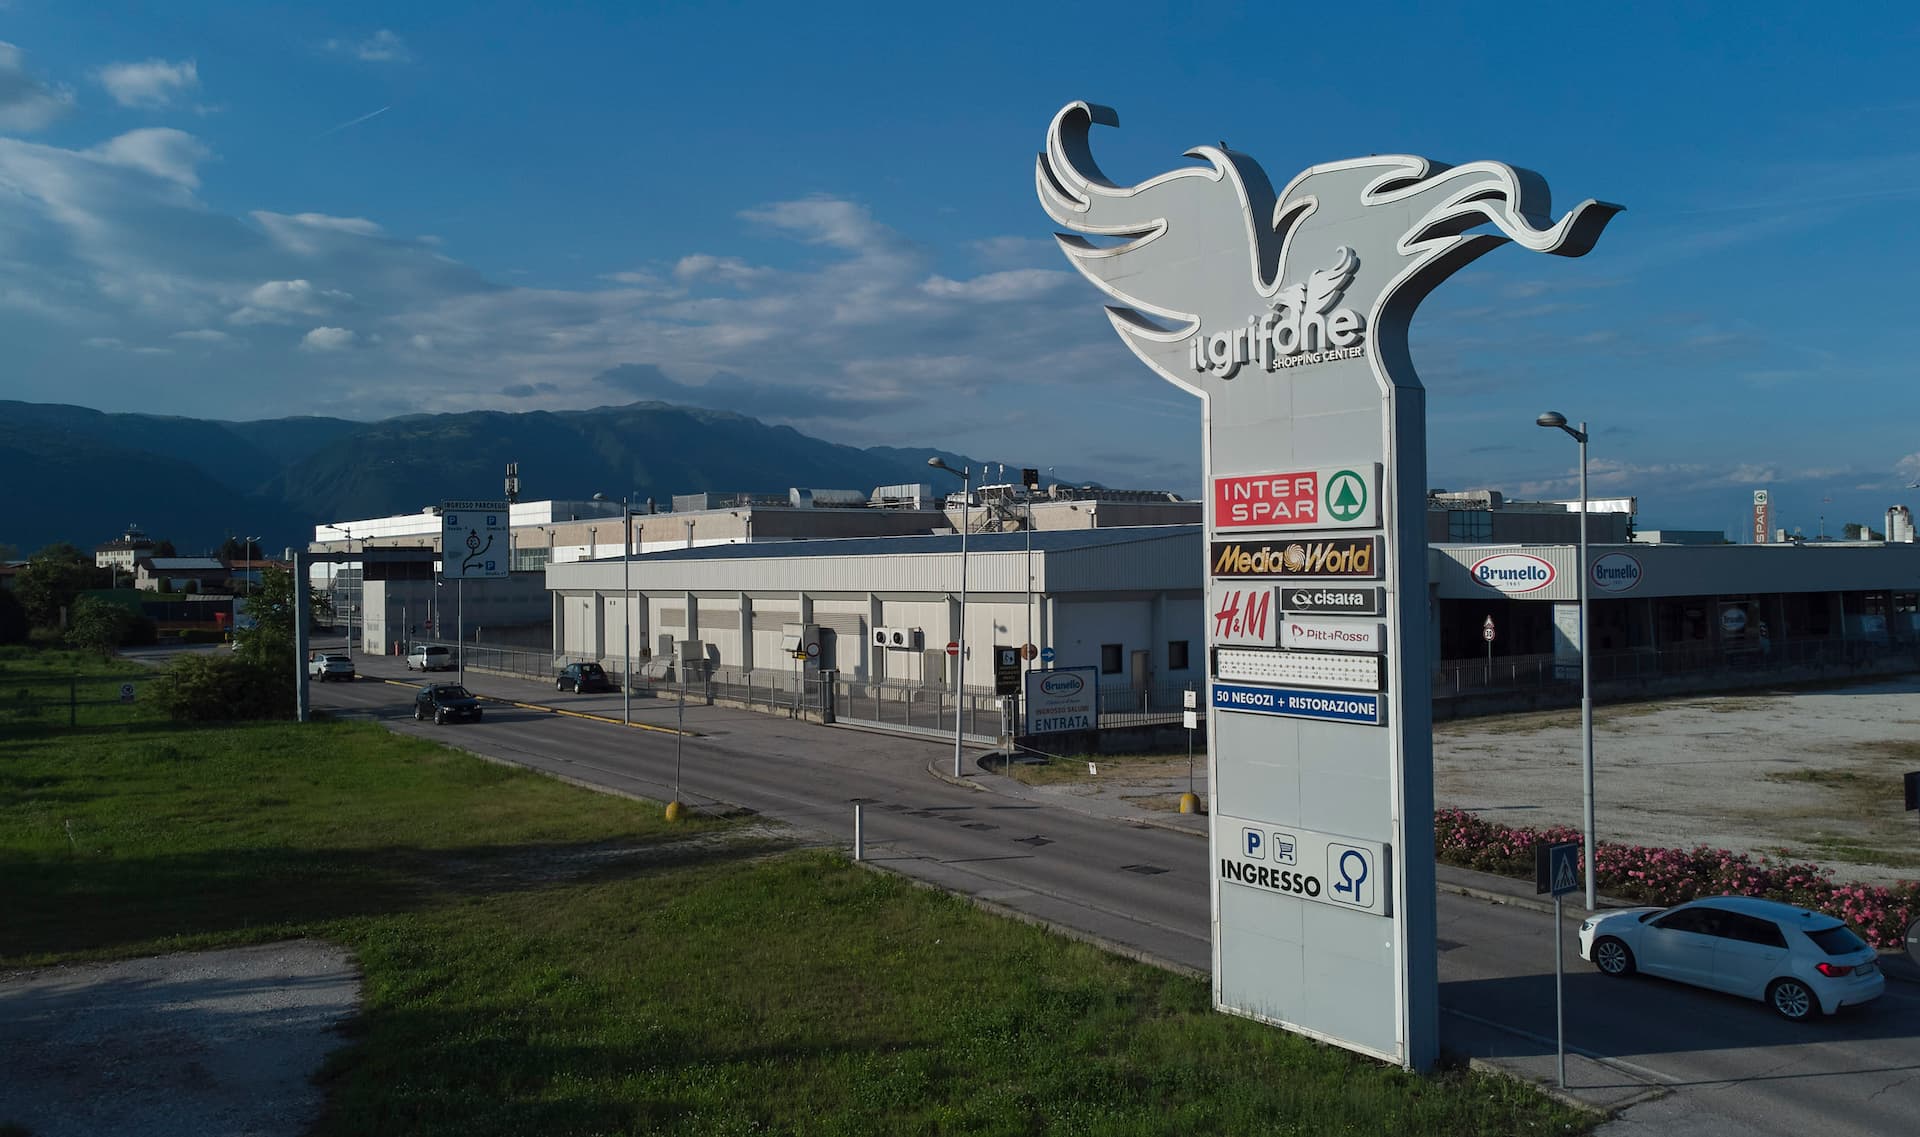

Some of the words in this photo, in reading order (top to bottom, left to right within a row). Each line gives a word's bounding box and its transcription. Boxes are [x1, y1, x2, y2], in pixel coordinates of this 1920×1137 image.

[1272, 352, 1321, 369] SHOPPING
[1323, 346, 1362, 361] CENTER
[1224, 478, 1315, 501] INTER
[1231, 500, 1315, 522] SPAR
[1214, 544, 1284, 573] Media
[1304, 542, 1371, 573] World
[1479, 565, 1547, 580] Brunello
[1596, 564, 1638, 579] Brunello
[1313, 589, 1364, 606] cisalfa
[1214, 590, 1271, 641] H&M
[1306, 628, 1370, 642] PittaRosso
[1045, 679, 1081, 691] Brunello
[1216, 690, 1229, 703] 50
[1231, 691, 1274, 706] NEGOZI
[1288, 697, 1376, 715] RISTORAZIONE
[1035, 715, 1089, 731] ENTRATA
[1247, 832, 1261, 854] P
[1221, 858, 1321, 897] INGRESSO
